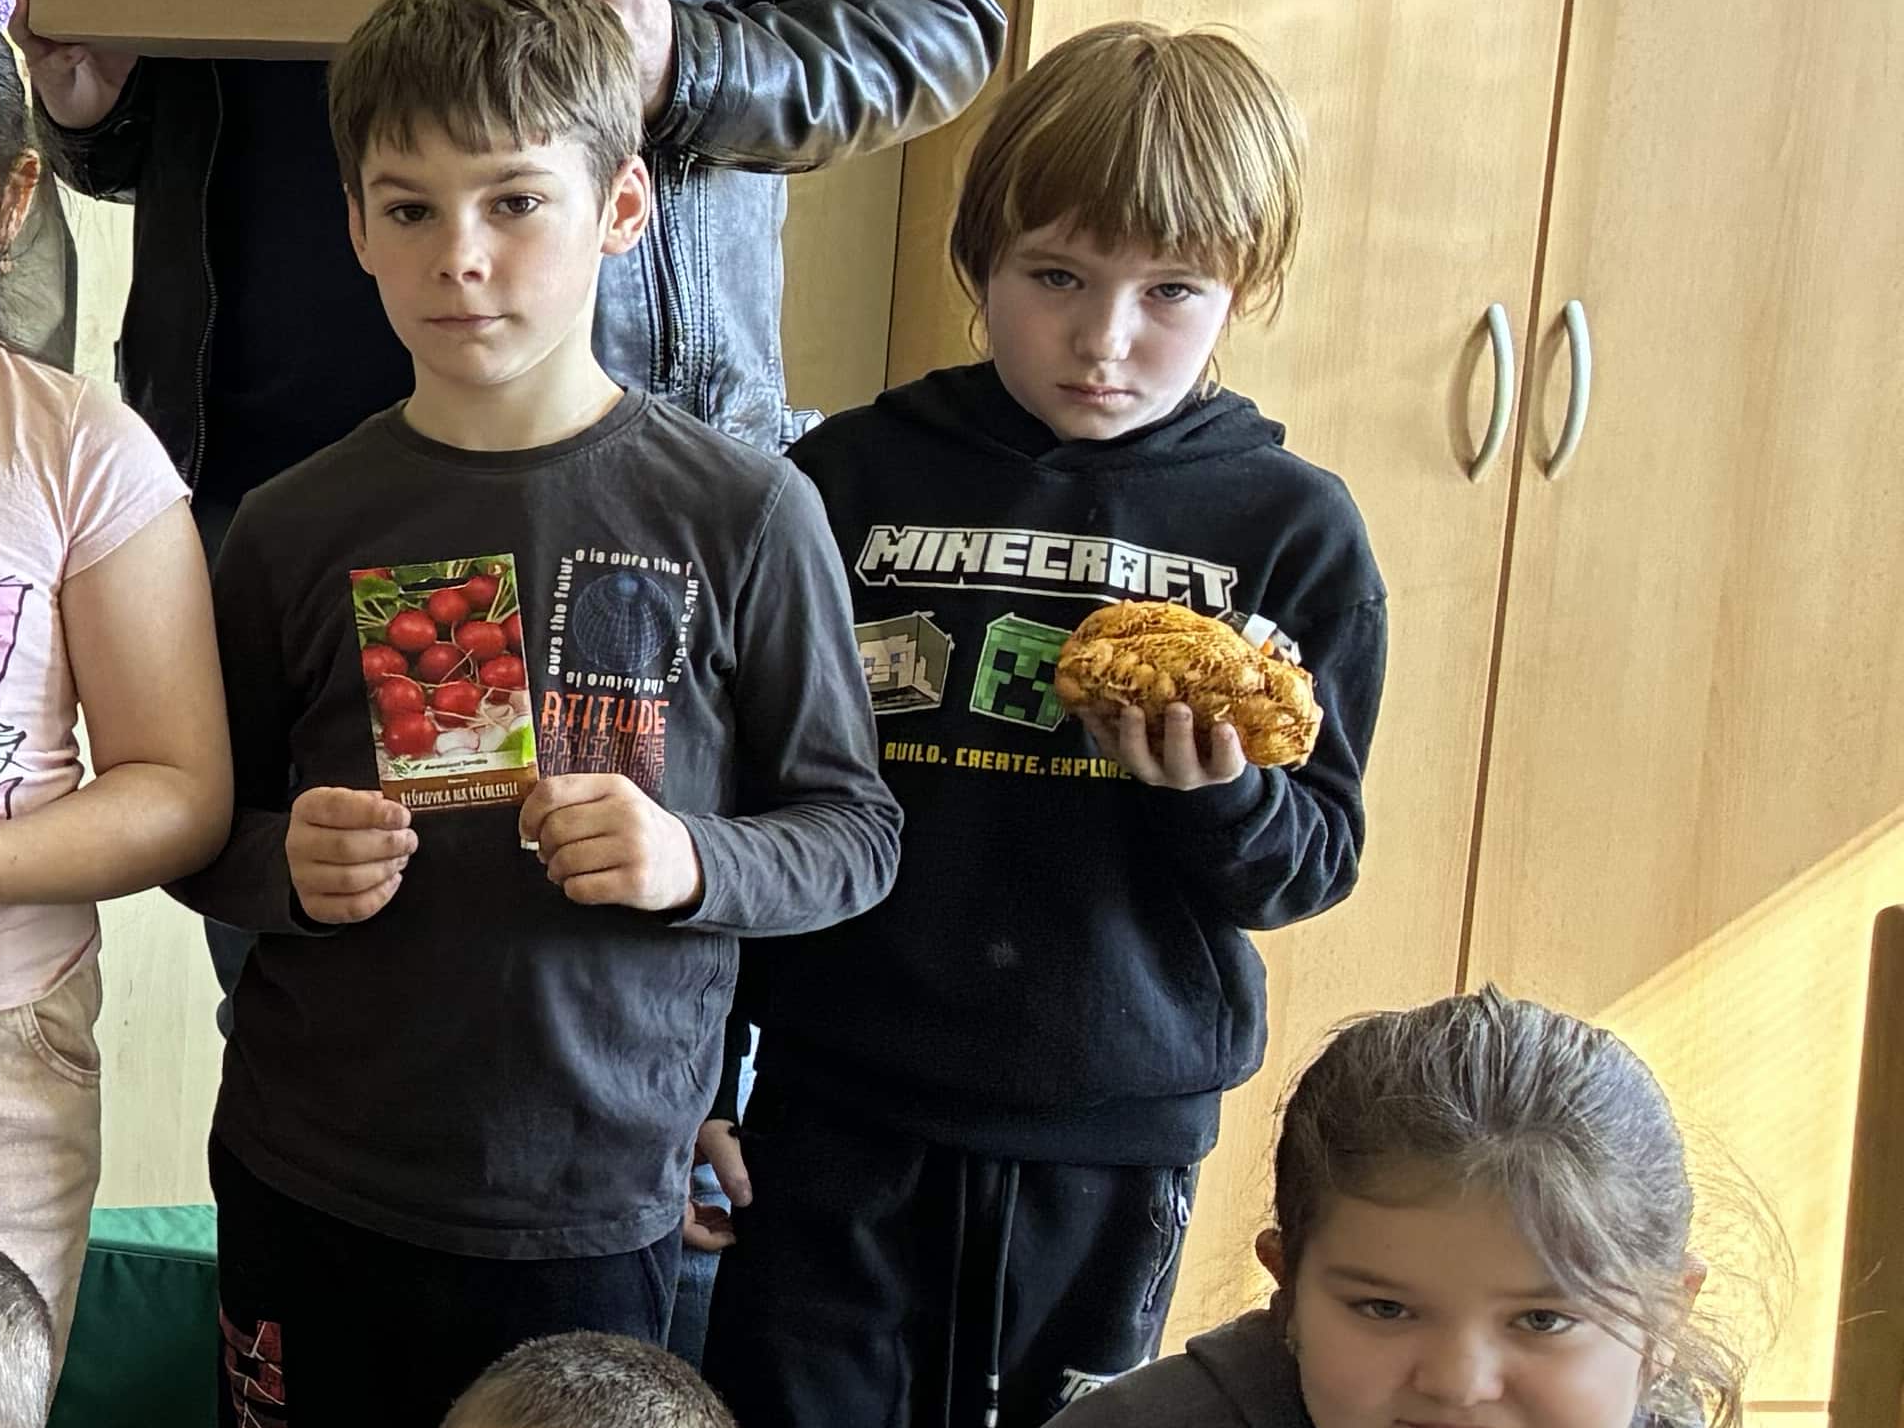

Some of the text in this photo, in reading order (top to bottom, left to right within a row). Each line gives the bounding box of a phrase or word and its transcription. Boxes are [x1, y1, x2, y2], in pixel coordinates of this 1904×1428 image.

[860, 528, 1236, 608] MINECRAFT
[884, 742, 948, 765] BUILD.
[955, 747, 1046, 775] CREATE.
